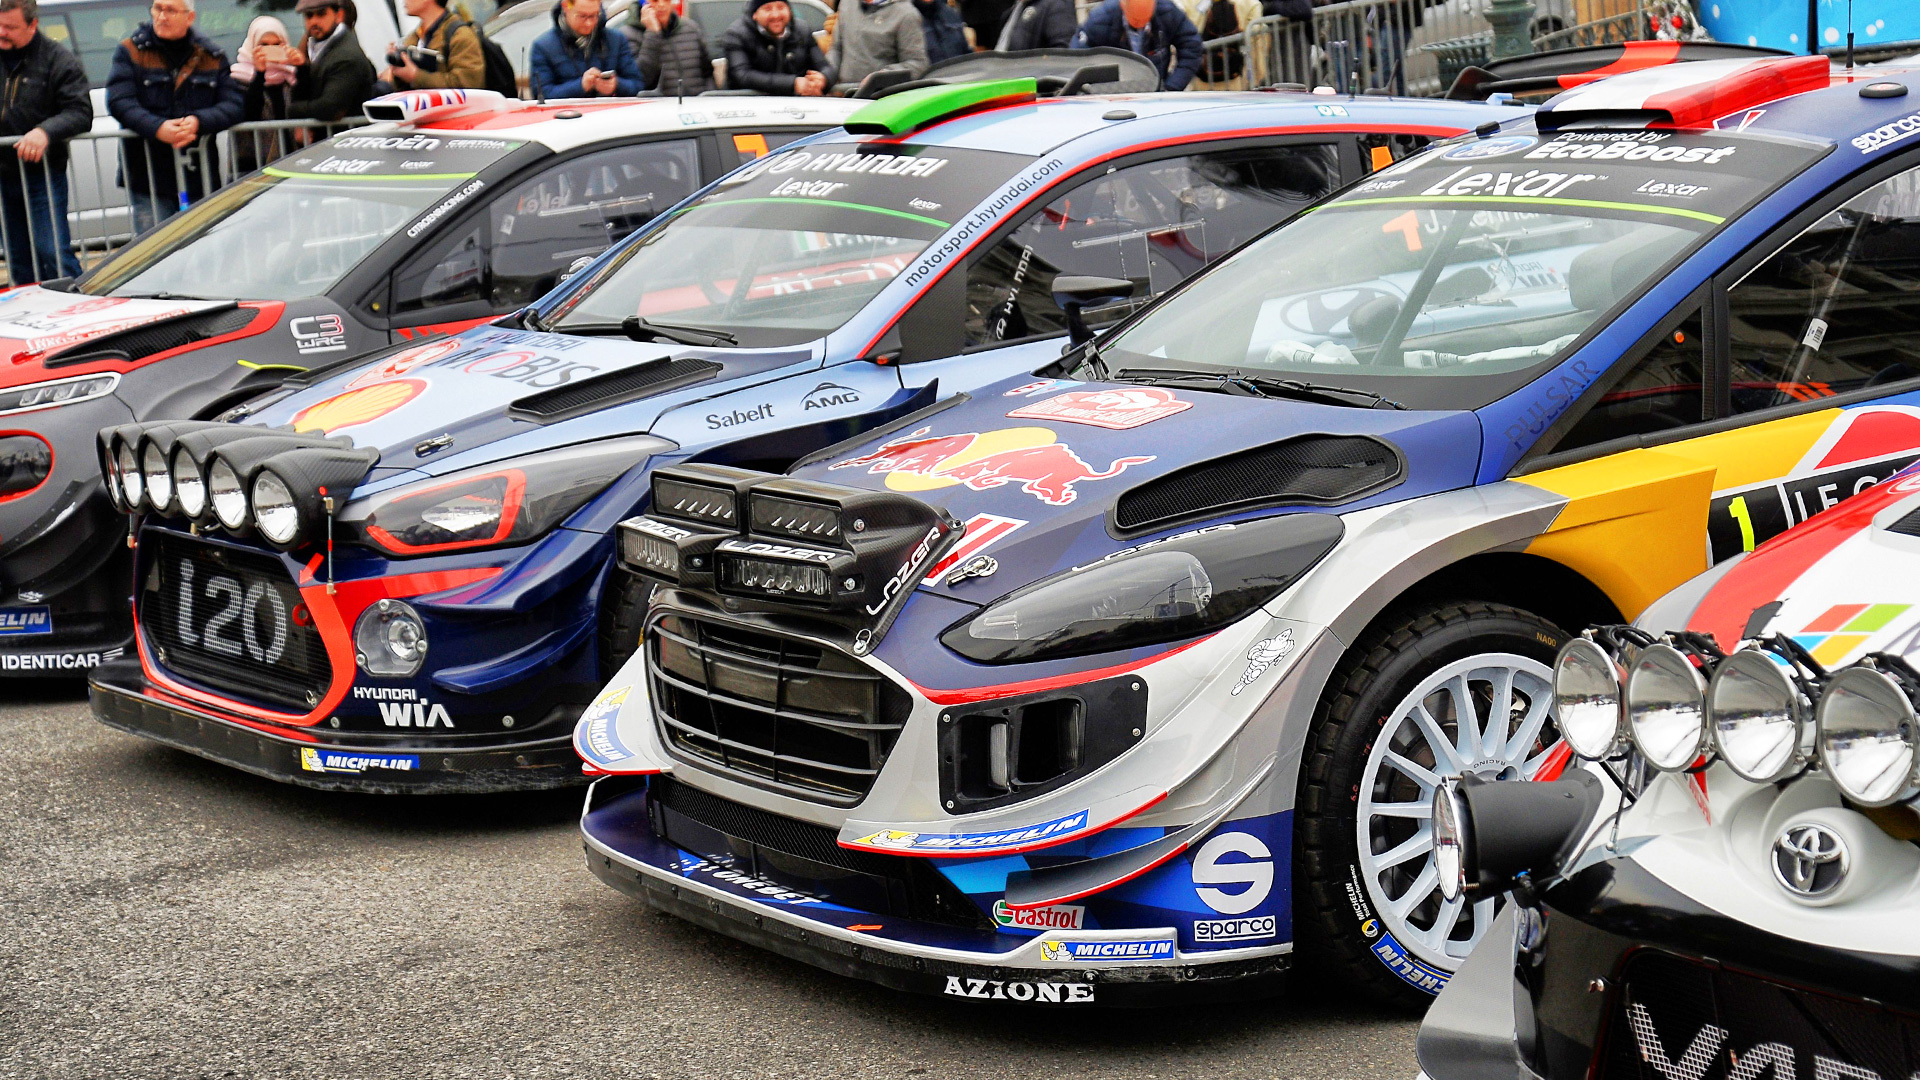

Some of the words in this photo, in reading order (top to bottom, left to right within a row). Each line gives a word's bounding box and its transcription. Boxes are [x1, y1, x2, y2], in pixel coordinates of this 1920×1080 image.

[1554, 131, 1640, 142] Powered
[1643, 132, 1671, 142] by
[1523, 141, 1737, 164] EcoBoost
[311, 156, 380, 173] Lexar
[801, 154, 949, 177] HYUNDAI
[770, 177, 842, 196] Lexar
[1420, 166, 1600, 197] Lexar
[1636, 179, 1709, 196] Lexar
[407, 180, 485, 238] CITROENRACING.COM
[904, 157, 1063, 287] motorsport.hyundai.com
[290, 315, 343, 339] C3
[296, 336, 347, 347] WRC
[424, 344, 600, 387] MOBIS
[804, 391, 860, 410] AMG
[1504, 359, 1601, 451] PULSAR
[705, 402, 775, 430] Sabelt
[1, 653, 100, 670] IDENTICAR
[353, 686, 417, 700] HYUNDAI
[378, 697, 455, 727] WIA
[590, 718, 628, 762] MICHELIN
[325, 754, 413, 770] MICHELIN
[917, 814, 1086, 846] MICHELIN
[1345, 882, 1367, 921] MICHELIN
[1014, 907, 1078, 929] Castrol
[1196, 918, 1275, 940] sparco
[1074, 942, 1173, 957] MICHELIN
[943, 976, 1095, 1002] AZIONE
